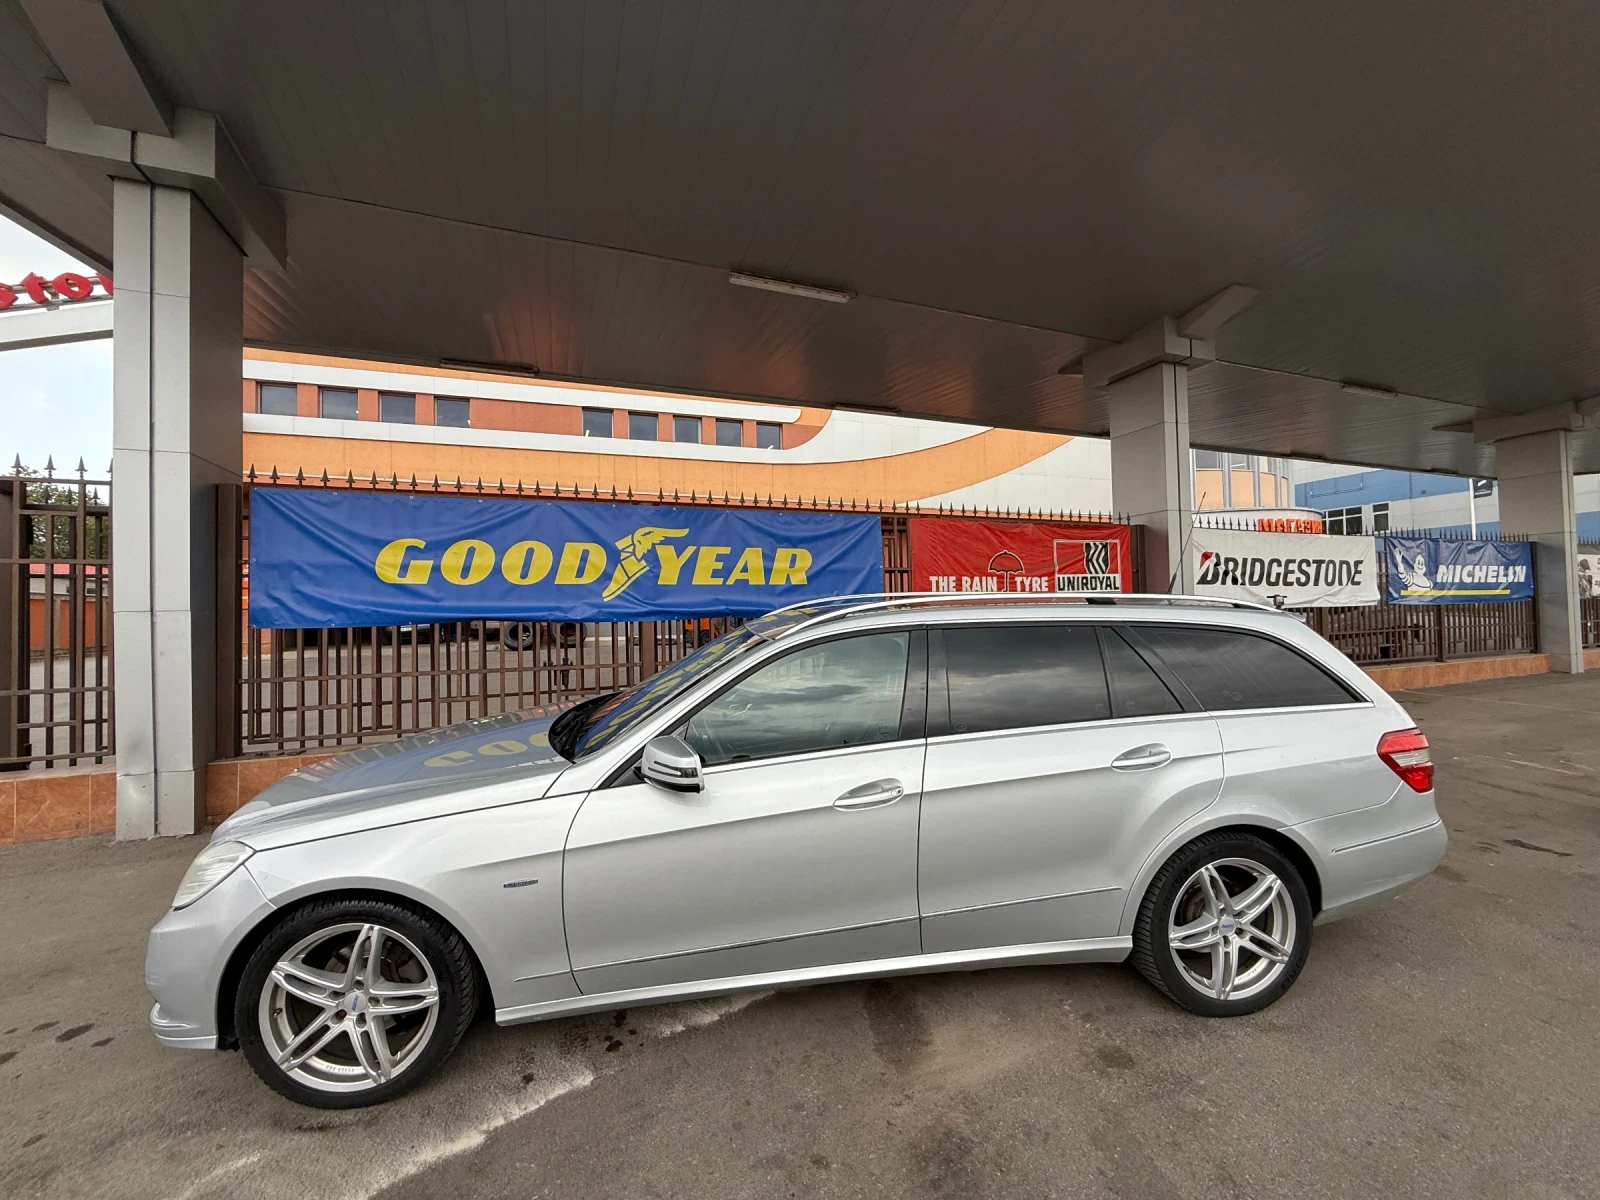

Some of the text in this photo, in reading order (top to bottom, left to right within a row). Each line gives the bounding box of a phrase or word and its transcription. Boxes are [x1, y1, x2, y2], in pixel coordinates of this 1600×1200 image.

[375, 538, 813, 586] GOOD YEAR
[1196, 551, 1364, 587] BRIDGESTONE
[1436, 564, 1527, 583] MICHELIN
[929, 575, 1048, 592] THE RAIN TYRE
[1056, 575, 1121, 592] UNIROYAL
